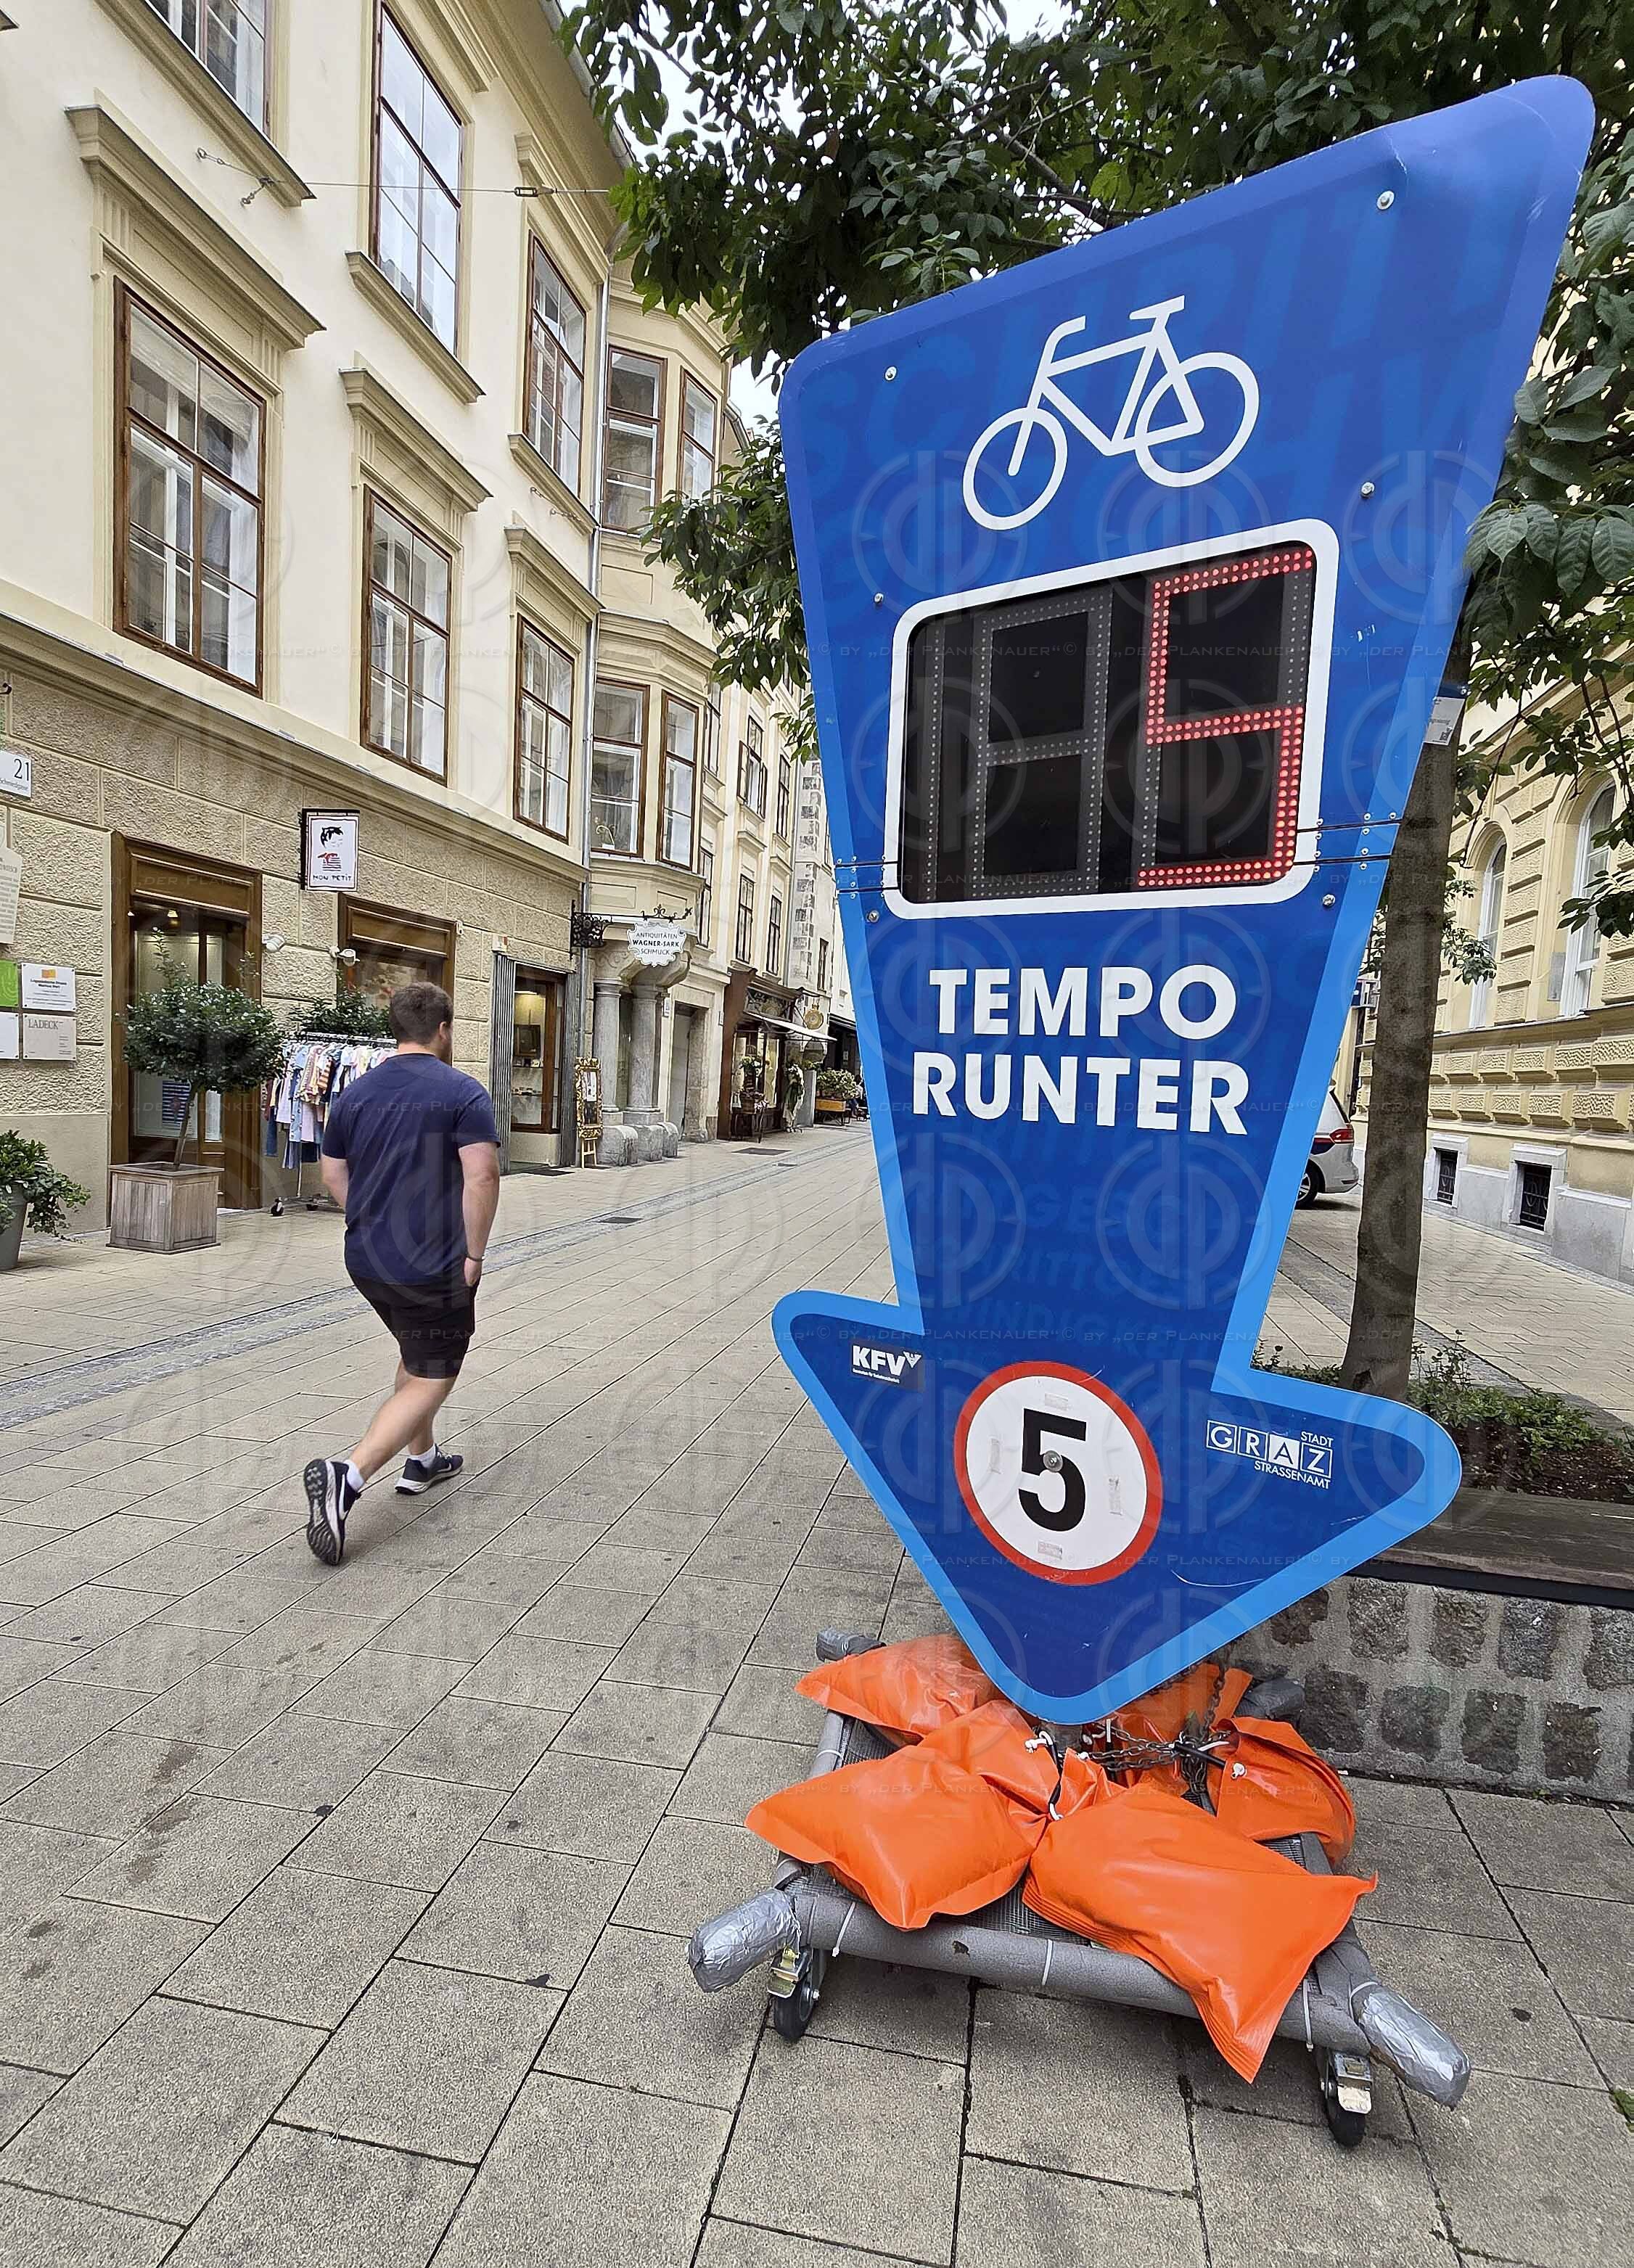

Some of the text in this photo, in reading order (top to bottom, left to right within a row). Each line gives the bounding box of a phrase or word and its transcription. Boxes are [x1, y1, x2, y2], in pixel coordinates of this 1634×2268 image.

[1137, 549, 1314, 889] 5
[15, 758, 29, 781] 21
[928, 964, 1237, 1040] TEMPO
[28, 1019, 59, 1030] LADECK
[912, 1051, 1249, 1136] RUNTER
[853, 1344, 906, 1376] KFV
[1208, 1422, 1329, 1476] GRAZ
[1300, 1431, 1334, 1448] STADT
[1018, 1407, 1087, 1532] 5
[1254, 1460, 1331, 1490] STRASSENAMT
